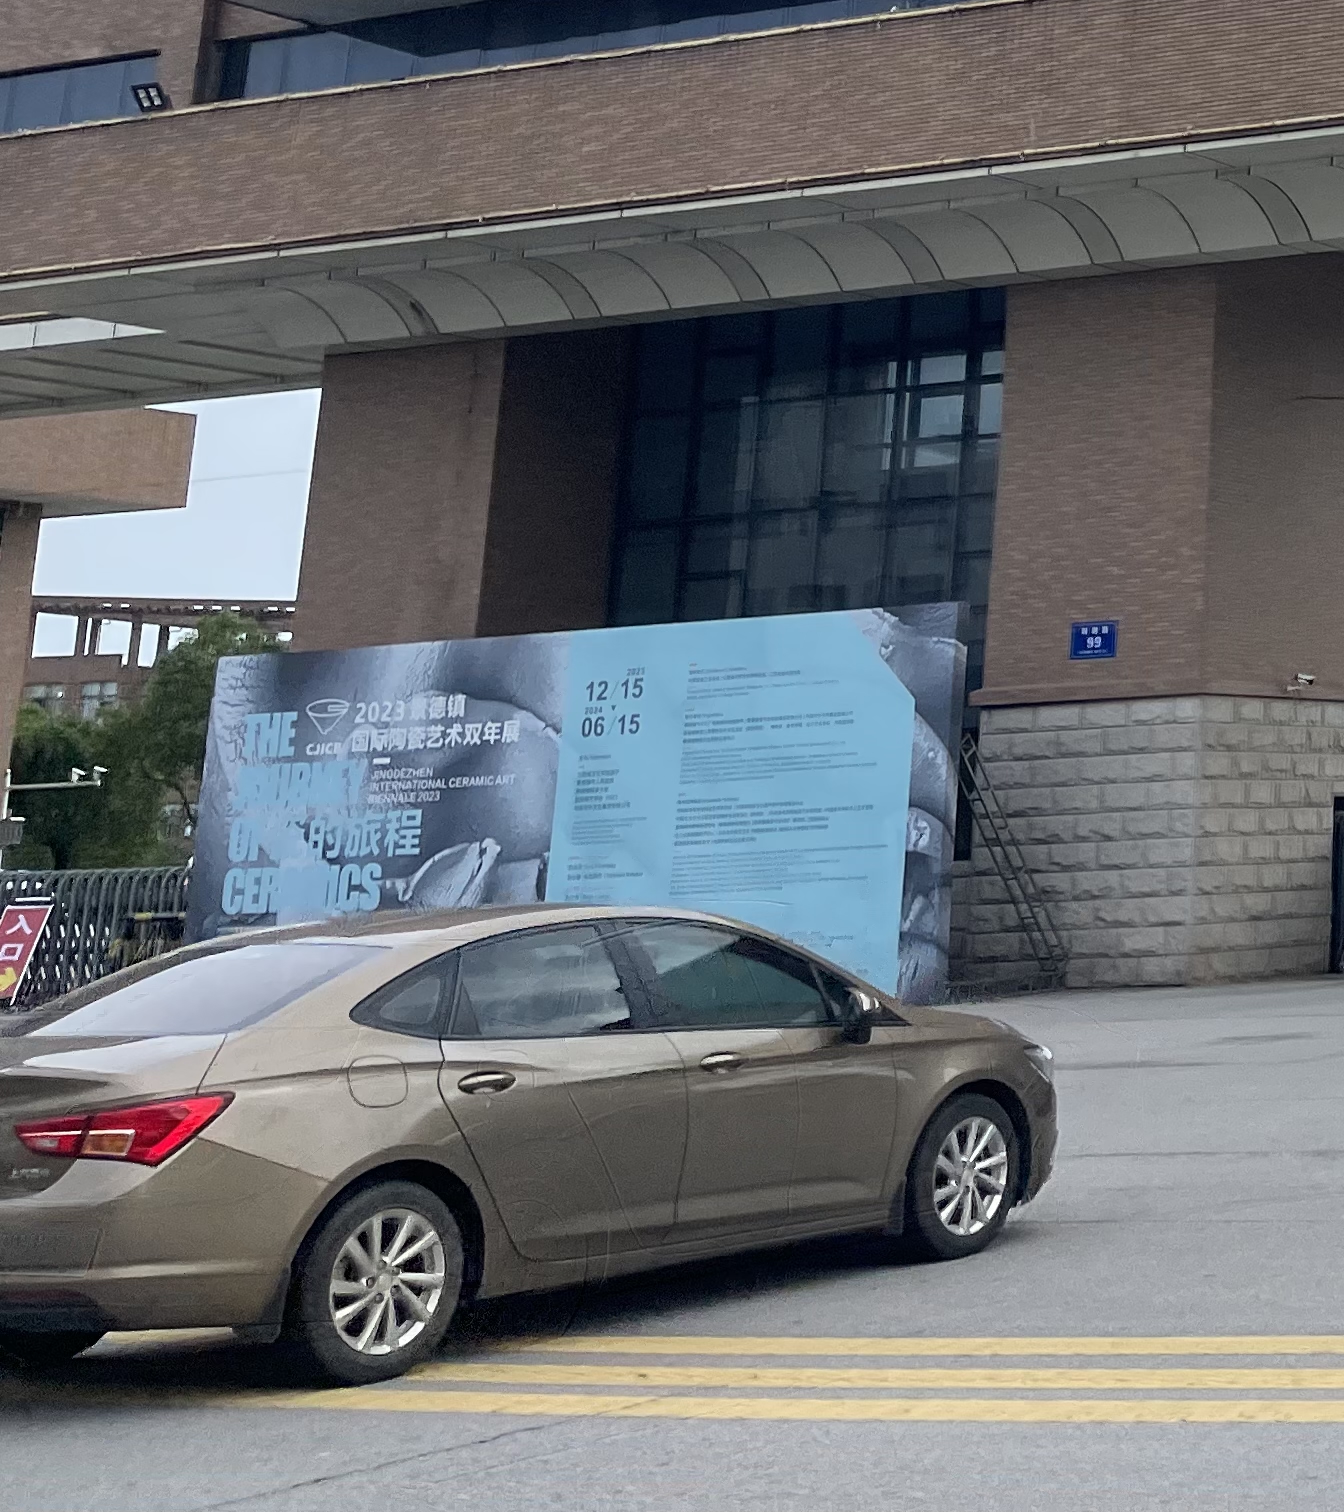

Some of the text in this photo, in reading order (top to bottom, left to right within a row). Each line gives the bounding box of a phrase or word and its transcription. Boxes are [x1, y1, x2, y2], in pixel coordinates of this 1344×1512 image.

[242, 711, 298, 760] THE
[351, 720, 521, 753] 国际陶瓷艺术双年展
[449, 775, 494, 789] CERAMIC
[417, 790, 441, 803] 2023
